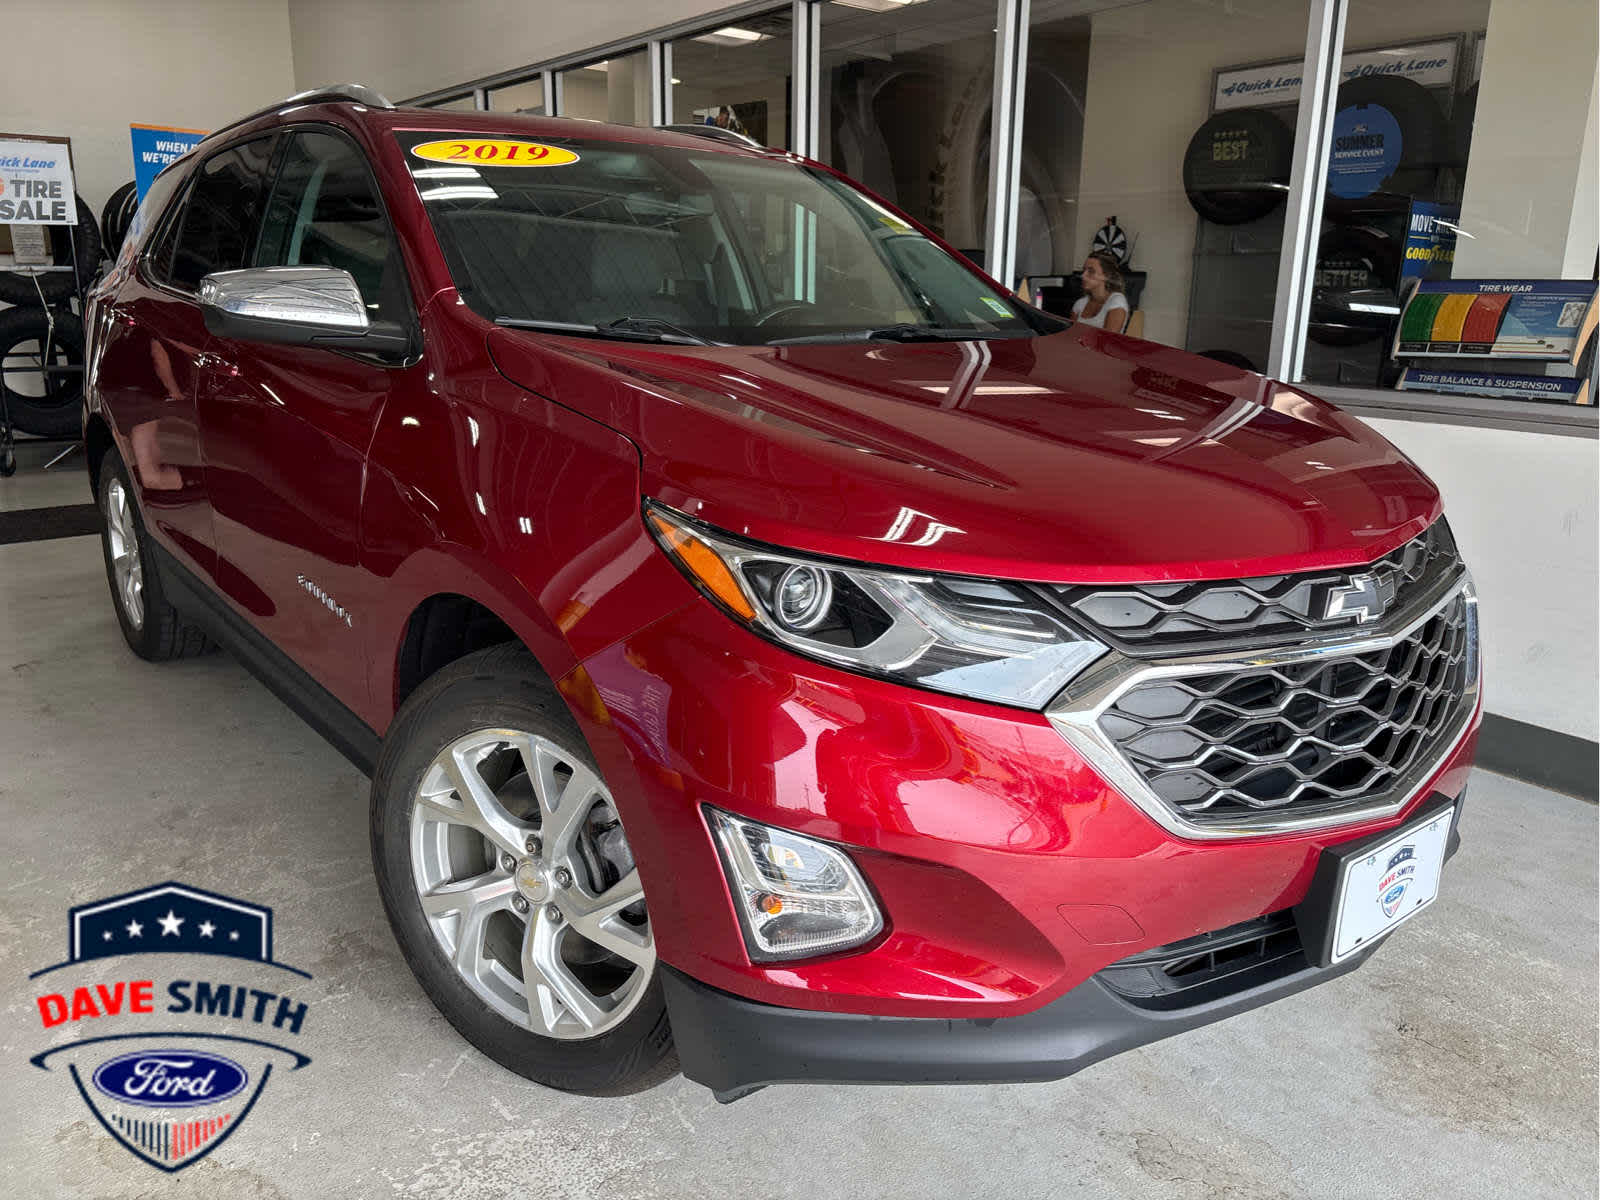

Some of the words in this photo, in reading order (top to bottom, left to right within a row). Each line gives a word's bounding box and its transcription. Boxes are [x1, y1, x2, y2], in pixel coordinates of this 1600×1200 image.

[1407, 58, 1448, 71] Lane
[1236, 78, 1273, 93] Quick
[1274, 76, 1303, 88] Lan
[156, 141, 188, 153] WHEN
[447, 144, 550, 160] 2019
[1213, 140, 1248, 161] BEST
[0, 157, 20, 168] ick
[23, 157, 56, 168] Lane
[10, 180, 62, 198] TIRE
[0, 200, 66, 221] SALE
[1410, 213, 1435, 233] MOVE
[1418, 374, 1439, 383] TIRE
[1440, 375, 1484, 386] BALANCE
[1485, 379, 1494, 387] &
[1494, 379, 1562, 392] SUSPENSION
